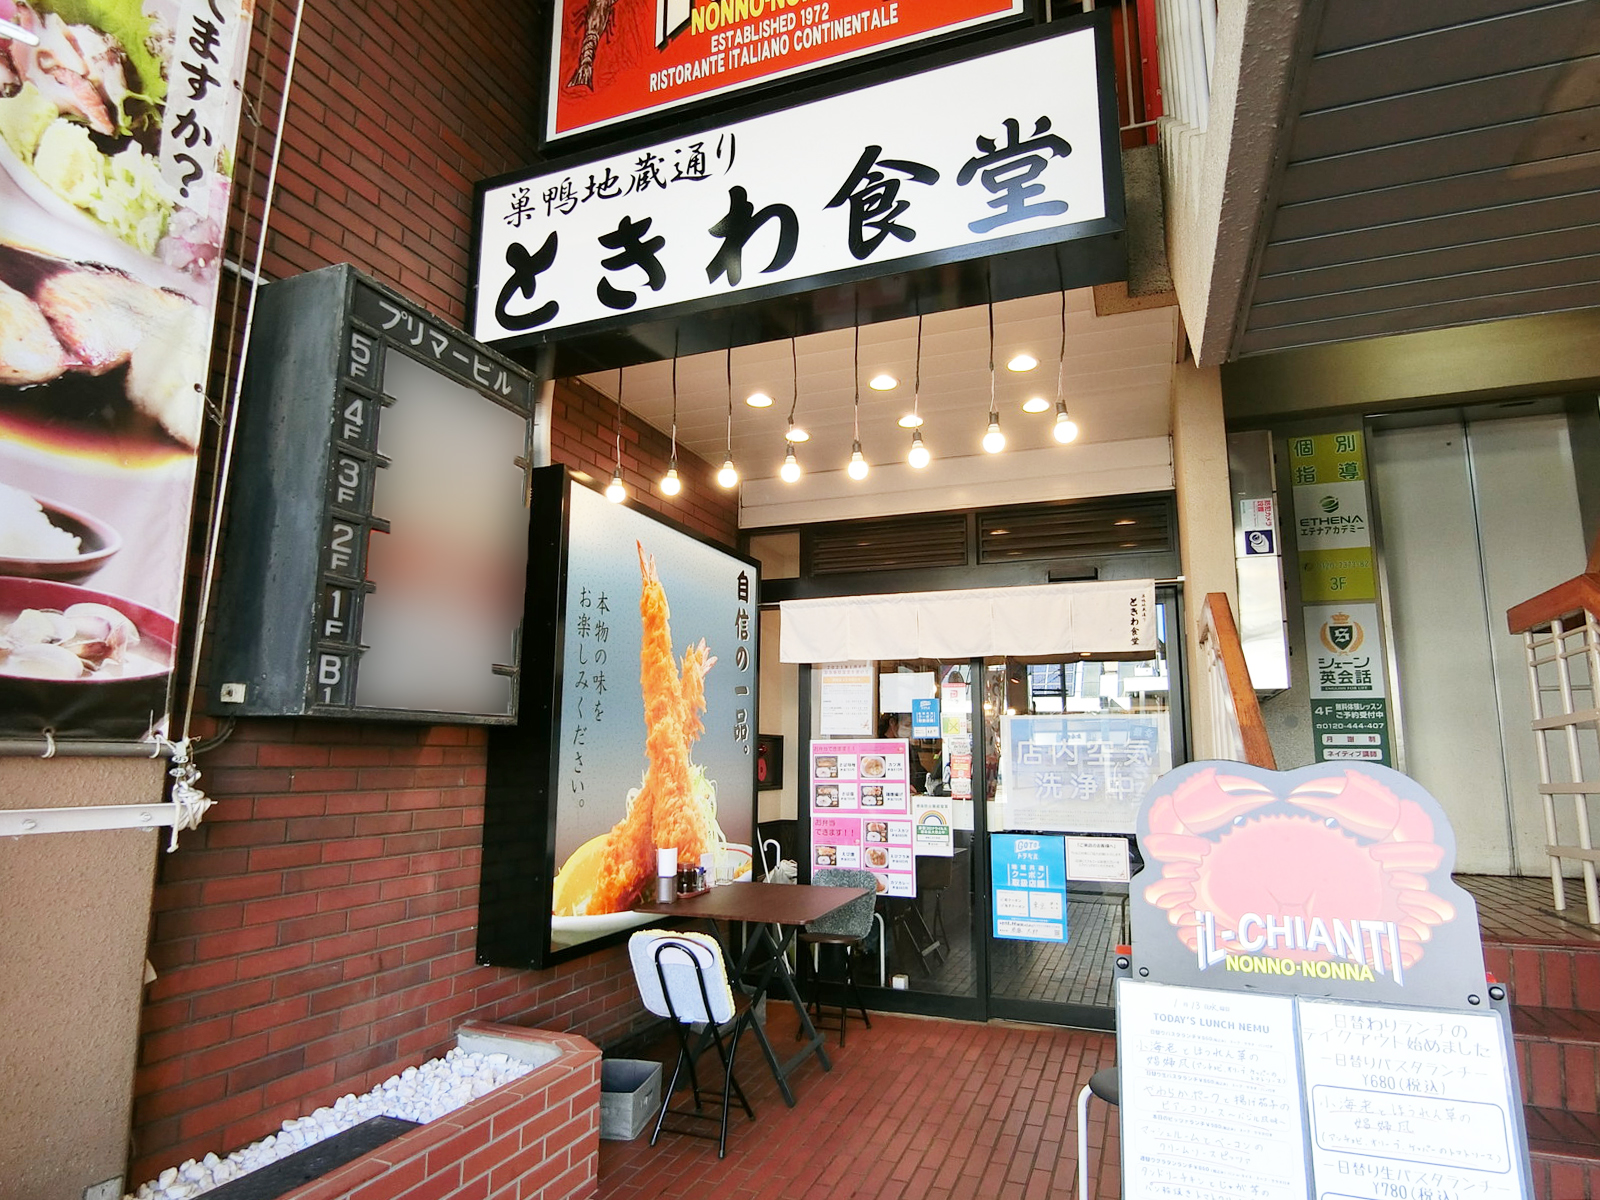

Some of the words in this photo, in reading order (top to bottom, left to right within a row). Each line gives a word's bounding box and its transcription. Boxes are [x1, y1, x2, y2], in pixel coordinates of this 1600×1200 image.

[711, 13, 797, 53] ESTABLISHED
[800, 2, 830, 27] 1972
[649, 52, 726, 93] RISTORANTE
[728, 34, 790, 71] ITALIANO
[793, 3, 899, 52] CONTINENTALE
[503, 133, 736, 228] 巣鴨地蔵通り
[494, 115, 1072, 331] ときわ食堂
[378, 300, 513, 396] プリマービル
[1293, 434, 1356, 457] 個別
[1295, 462, 1360, 484] 指導
[1300, 514, 1364, 527] ETHENA
[1300, 525, 1365, 536] エテナアカデミー
[1329, 576, 1347, 591] 3F
[1129, 597, 1140, 646] ときわ食堂
[592, 591, 610, 722] 本物の味を
[733, 570, 750, 756] 自信の一品。
[1318, 656, 1370, 670] シェーン
[1319, 669, 1372, 685] 英会話
[570, 586, 592, 809] お楽しみください。
[1314, 705, 1333, 716] 4F
[1322, 722, 1384, 730] 0120-444-407
[1335, 711, 1384, 720] ご予約受付中
[1017, 738, 1153, 767] 店内空気
[1034, 772, 1135, 801] 洗浄中
[1011, 871, 1045, 879] クーポン
[1152, 1012, 1196, 1027] TODAY'S
[1199, 1018, 1235, 1031] LUNCH
[1238, 1022, 1271, 1035] NEMU
[1334, 1013, 1469, 1040] 日替わりランチの
[1303, 1027, 1492, 1059] テイクアウト始めました
